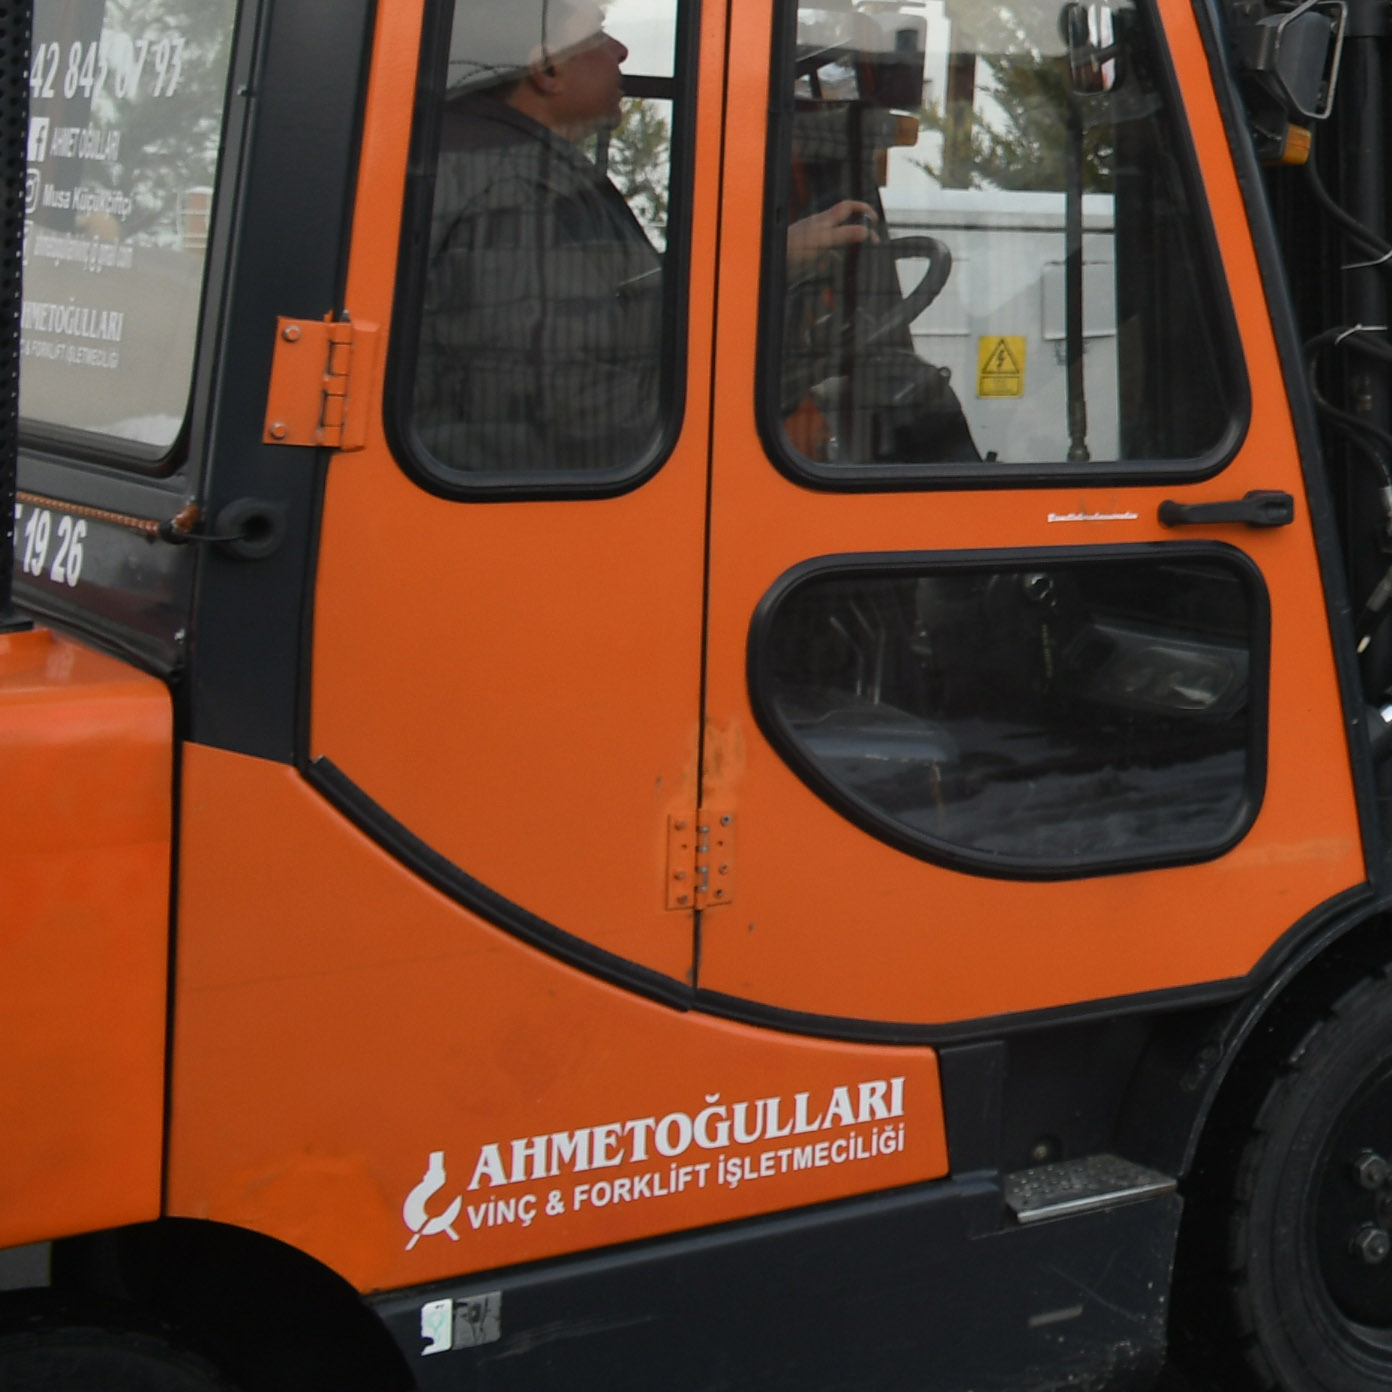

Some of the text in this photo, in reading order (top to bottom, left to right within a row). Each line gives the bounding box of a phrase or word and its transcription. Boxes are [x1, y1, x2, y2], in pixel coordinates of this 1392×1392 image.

[20, 297, 125, 342] HMETOĞULLARI
[50, 515, 87, 588] 26
[466, 1122, 906, 1231] VİNÇ & FORKLİFT İŞLETMECİLİĞİ
[467, 1077, 905, 1192] AHMETOĞULLARI
